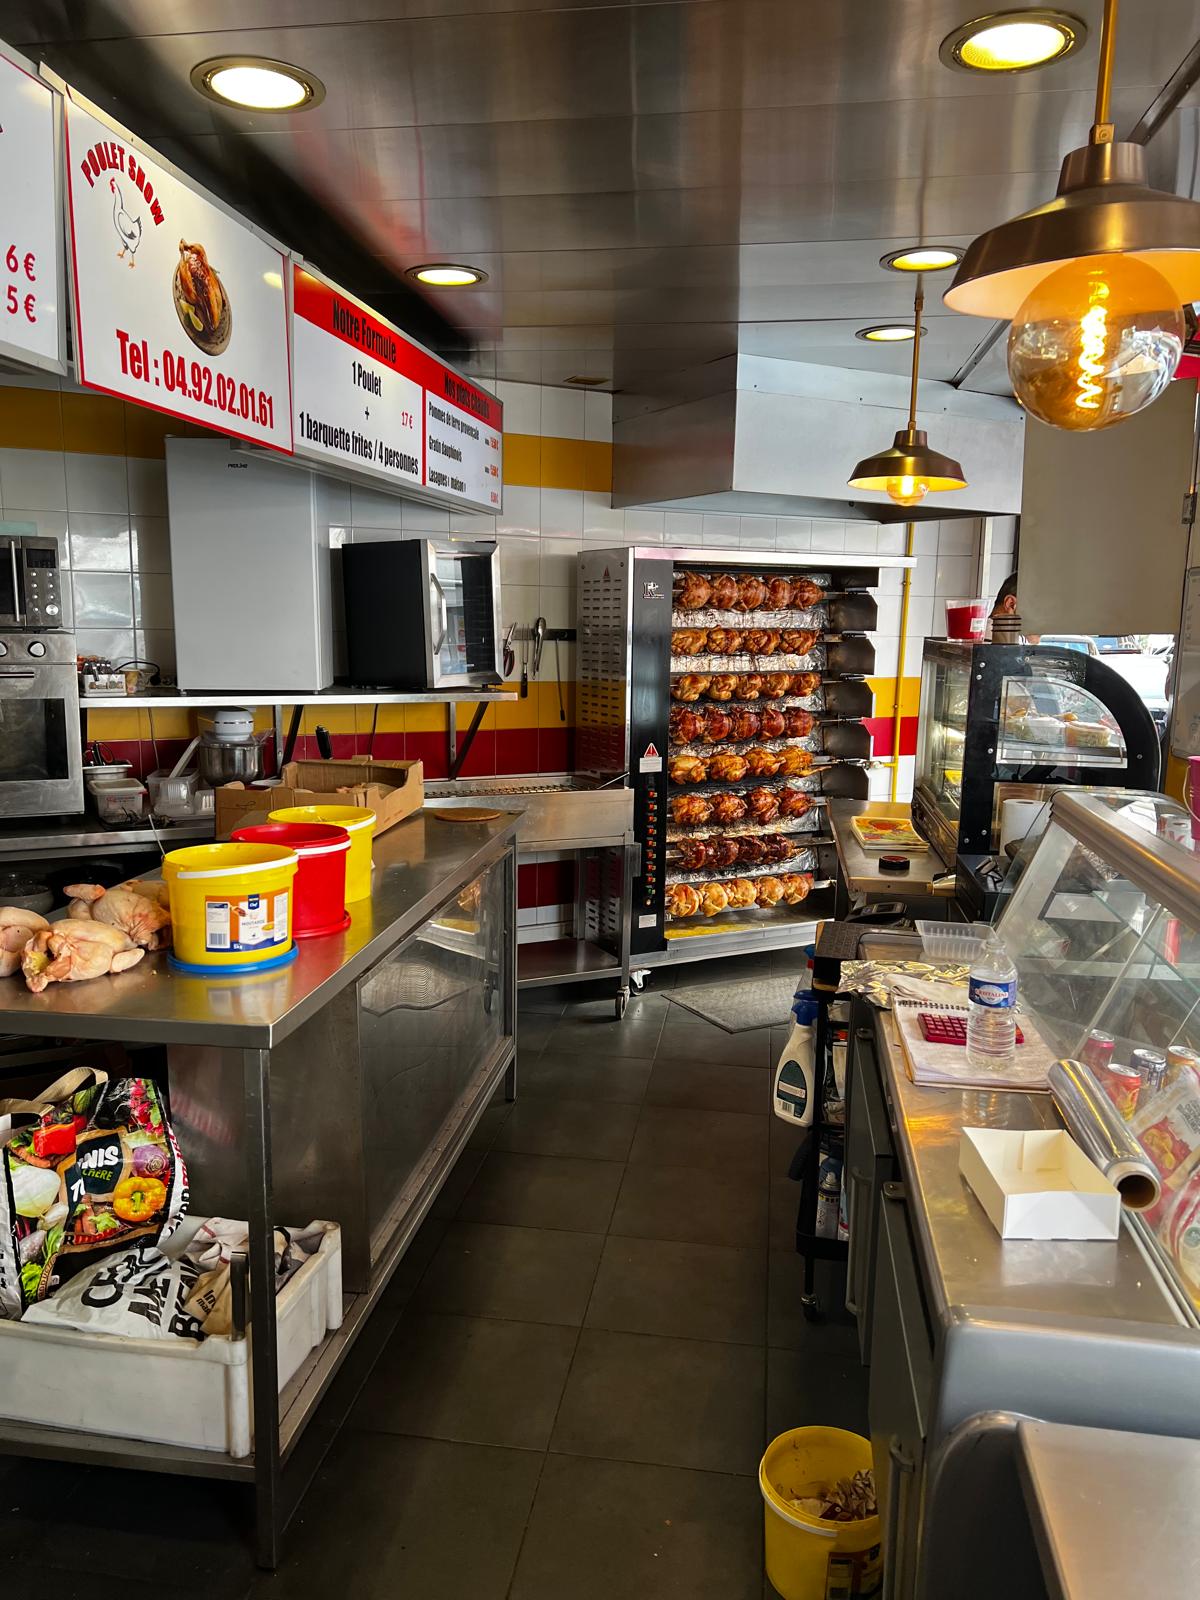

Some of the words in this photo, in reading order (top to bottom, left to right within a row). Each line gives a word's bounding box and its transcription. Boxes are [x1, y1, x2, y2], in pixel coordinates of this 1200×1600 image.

[80, 141, 125, 188] POULET
[128, 154, 165, 226] SHOW
[5, 244, 19, 273] 6
[23, 252, 36, 282] €
[6, 284, 19, 315] 5
[23, 293, 37, 323] €
[332, 299, 360, 342] Notre
[361, 317, 397, 363] Formule
[116, 329, 150, 383] Tel
[162, 349, 274, 429] 04.92.02.01.61
[357, 367, 382, 398] Poulet
[428, 401, 446, 424] Pommes
[446, 411, 451, 426] de
[299, 411, 305, 437] 1
[306, 413, 350, 453] barquette
[351, 431, 373, 461] frites
[378, 440, 384, 464] 4
[384, 443, 419, 476] personnes
[428, 435, 441, 454] Gratin
[428, 466, 448, 488] Lasagnes
